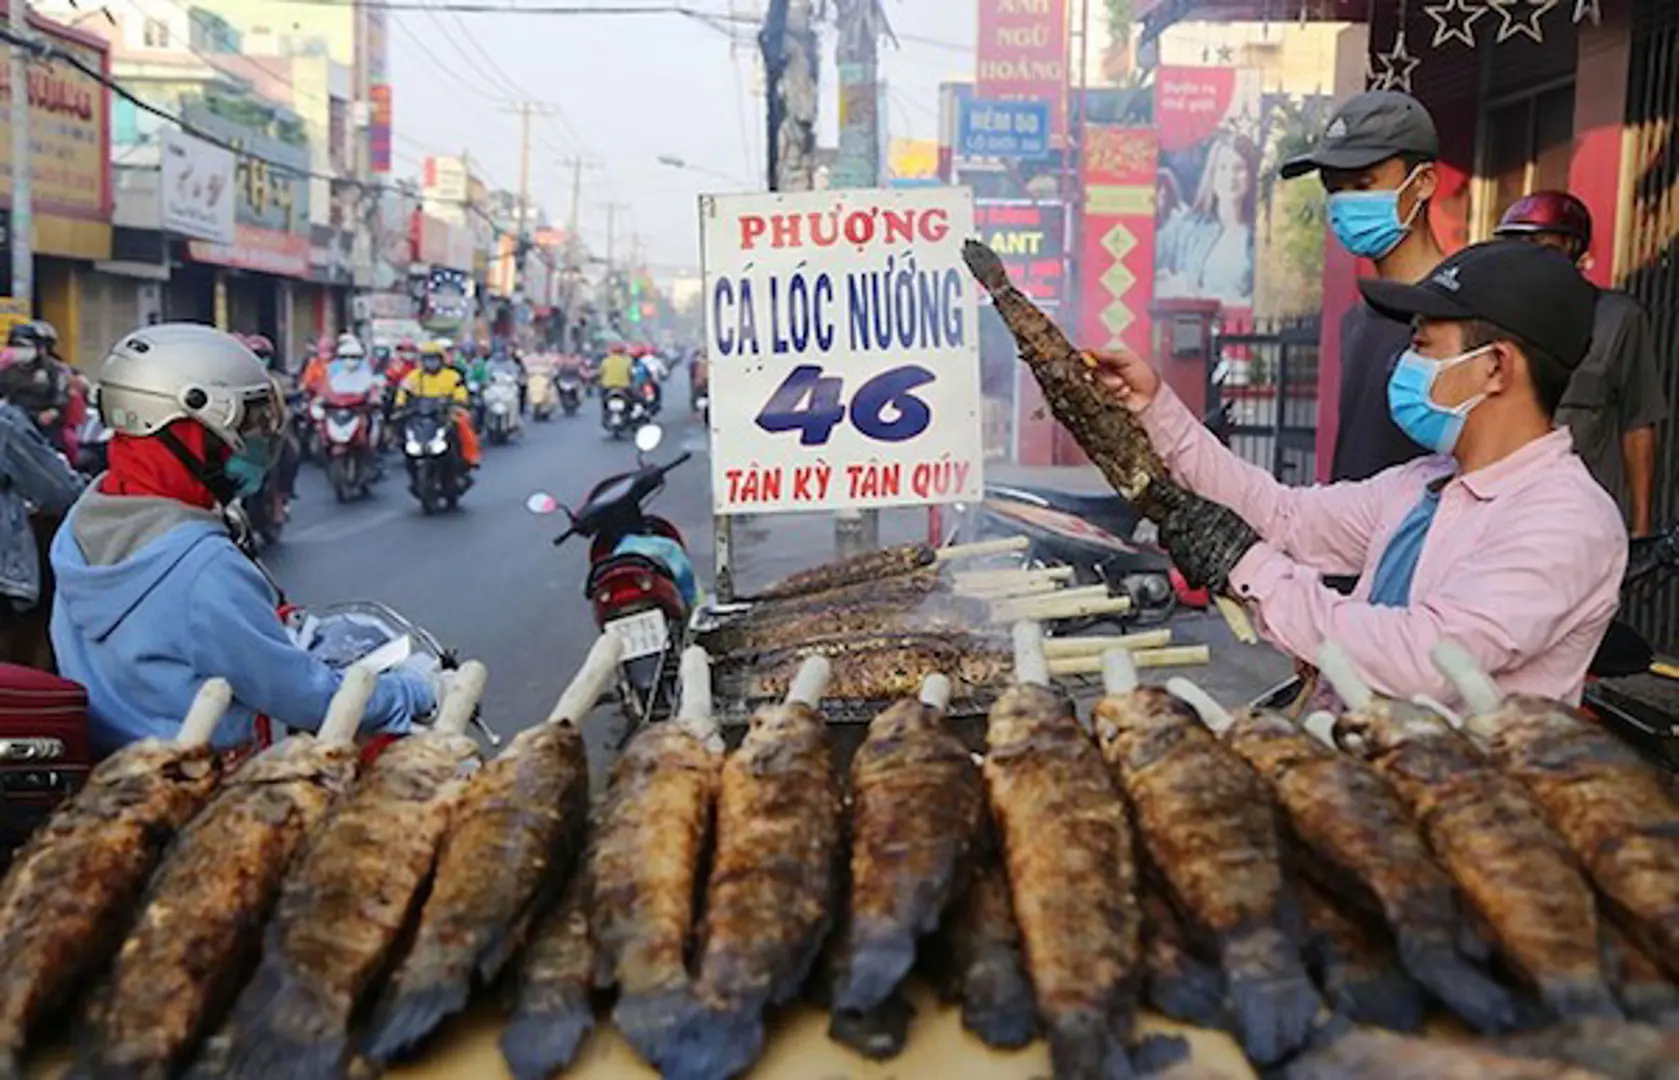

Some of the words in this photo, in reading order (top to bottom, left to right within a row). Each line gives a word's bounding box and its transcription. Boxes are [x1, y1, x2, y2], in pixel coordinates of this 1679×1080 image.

[738, 203, 951, 252] PHƯỢNG
[713, 262, 759, 357] CÁ
[770, 260, 835, 354] LÓC
[846, 249, 966, 354] NƯỚNG
[754, 363, 937, 447] 46
[725, 461, 782, 505] TÂN
[793, 458, 833, 501] KỲ
[846, 457, 902, 499] TÂN
